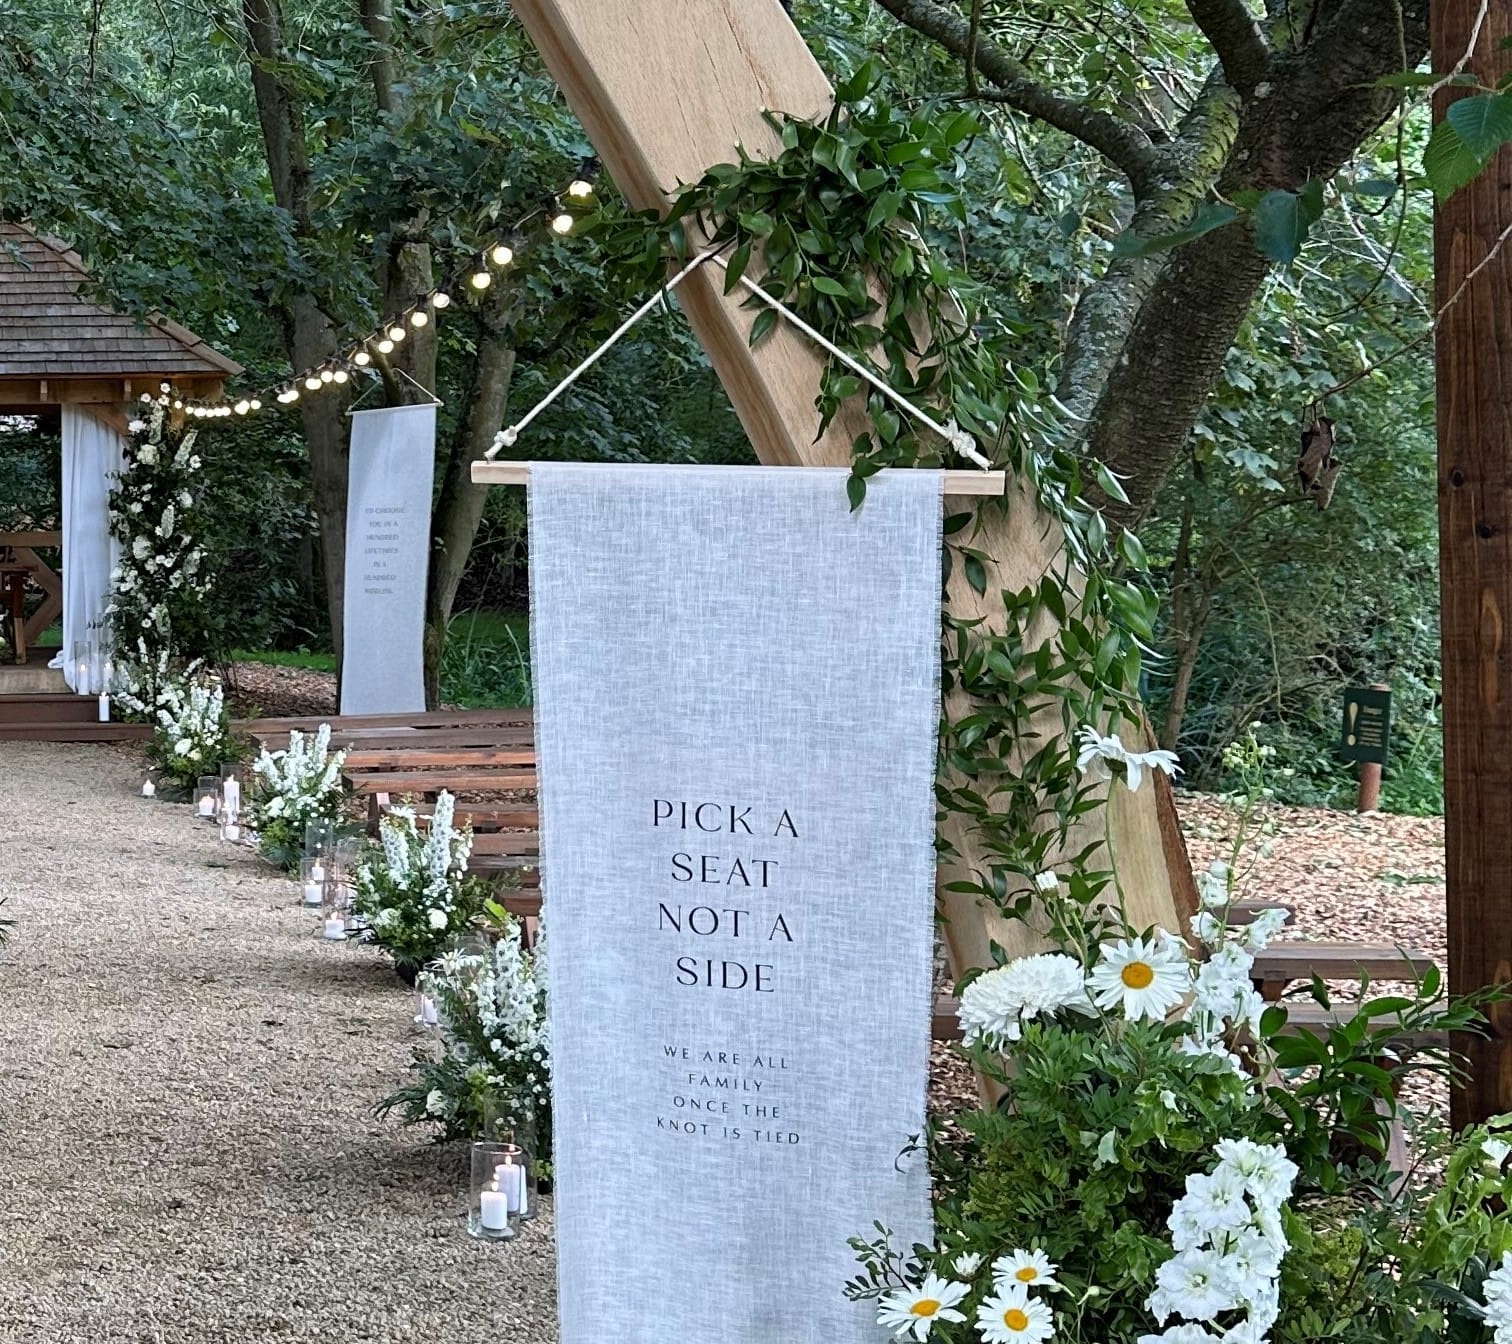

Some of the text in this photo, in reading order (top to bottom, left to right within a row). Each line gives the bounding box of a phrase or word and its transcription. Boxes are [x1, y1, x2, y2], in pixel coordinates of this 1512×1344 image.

[653, 799, 800, 838] PICK A
[671, 852, 779, 887] SEAT
[659, 902, 794, 942] NOT A
[676, 956, 775, 992] SIDE
[663, 1044, 788, 1069] WE ARE ALL
[688, 1073, 763, 1092] FAMILY
[673, 1095, 780, 1118] ONCE THE
[656, 1116, 800, 1145] KNOT IS TIED
